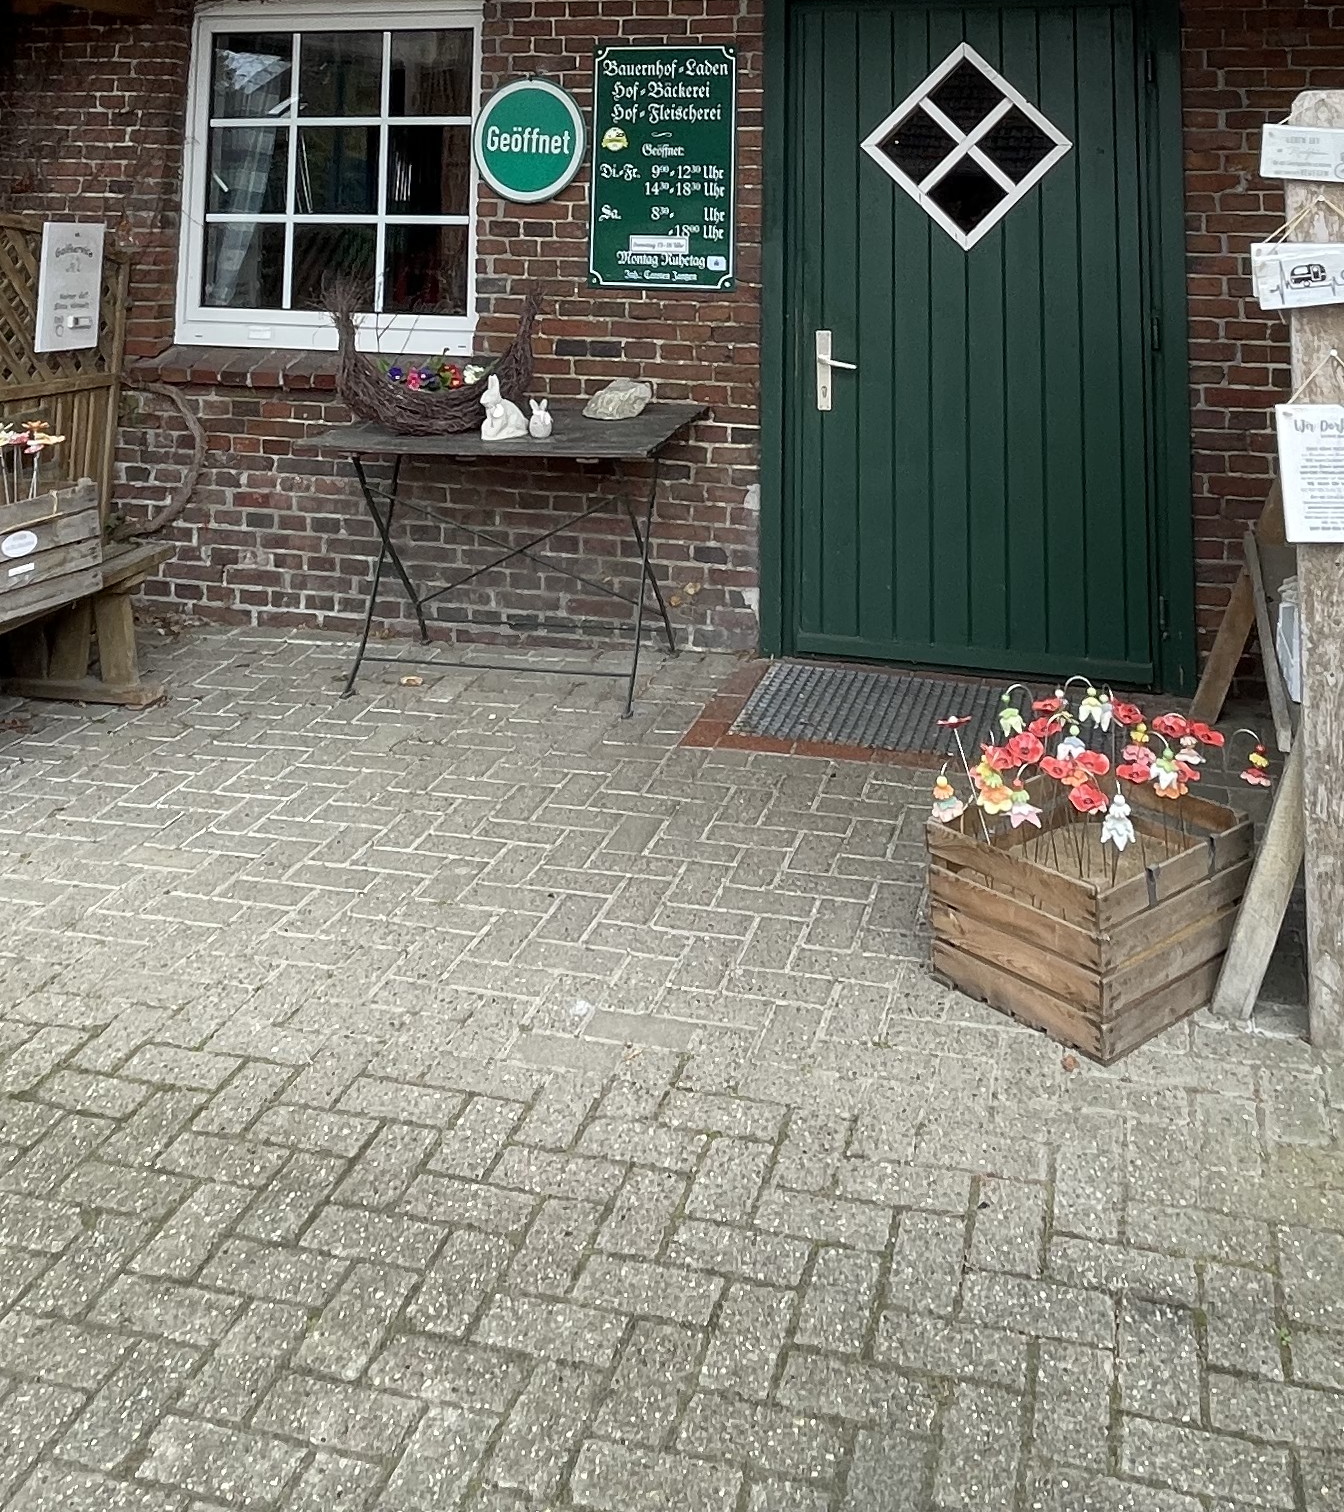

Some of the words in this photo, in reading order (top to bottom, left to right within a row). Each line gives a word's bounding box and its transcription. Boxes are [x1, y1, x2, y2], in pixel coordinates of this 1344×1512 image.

[486, 125, 571, 155] Geöffnet
[703, 165, 724, 181] Uhr
[703, 182, 725, 199] Uhr
[598, 204, 622, 222] Sa.
[703, 207, 725, 224] Uhr
[702, 225, 724, 242] Uhr
[616, 251, 659, 267] Montag
